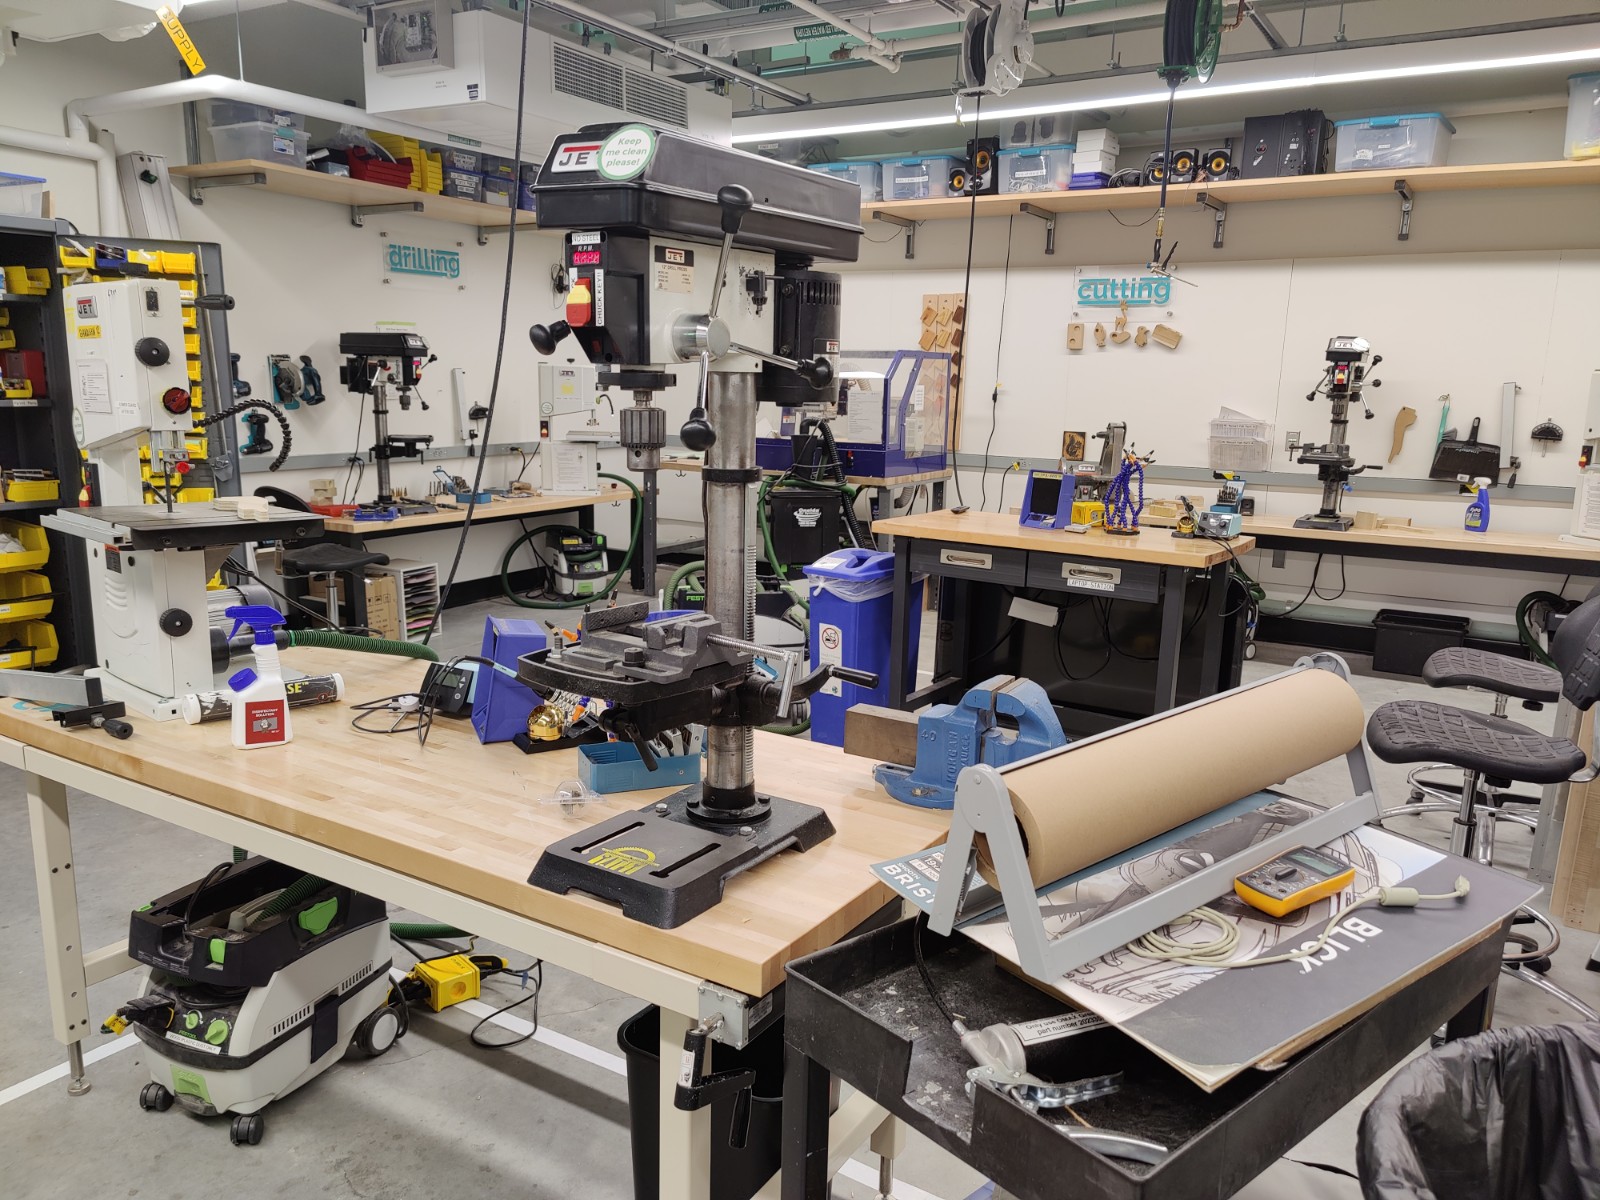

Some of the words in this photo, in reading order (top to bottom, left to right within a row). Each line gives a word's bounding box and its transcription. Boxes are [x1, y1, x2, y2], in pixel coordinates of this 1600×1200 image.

[617, 138, 642, 146] Keep
[559, 151, 600, 166] JE
[606, 158, 640, 168] please!
[582, 233, 601, 242] STEEL
[389, 245, 460, 278] drilling
[1077, 278, 1170, 304] cutting
[78, 304, 93, 315] JET
[921, 729, 937, 742] 40
[946, 730, 959, 784] MORGAN
[897, 862, 921, 880] SMOOTH
[1289, 916, 1383, 974] BLICK
[1037, 1027, 1052, 1036] part
[1052, 1021, 1078, 1032] number
